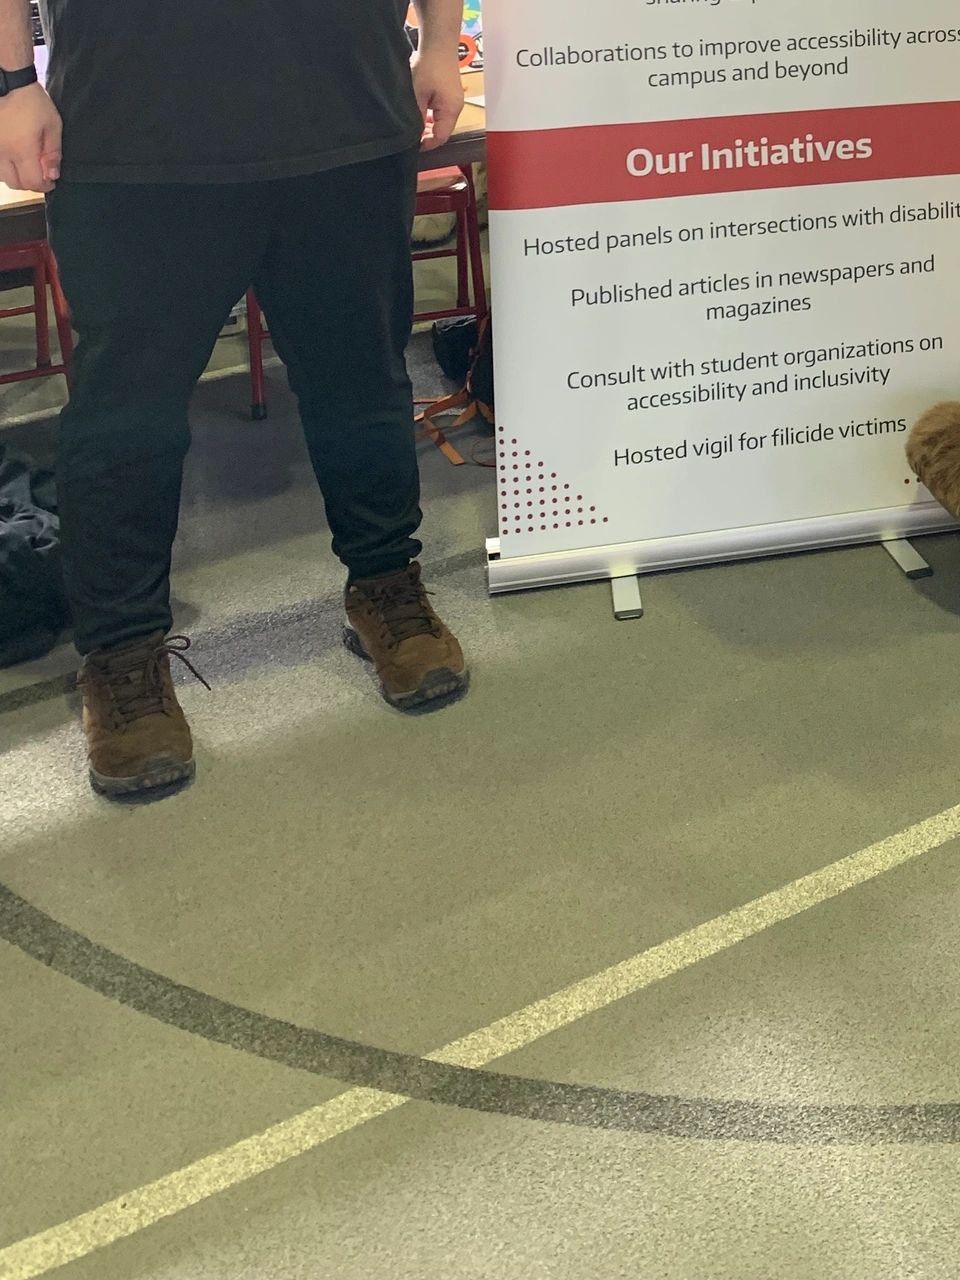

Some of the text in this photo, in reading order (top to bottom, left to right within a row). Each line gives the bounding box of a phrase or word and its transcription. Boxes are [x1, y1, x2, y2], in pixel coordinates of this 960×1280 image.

[516, 43, 667, 68] Collaborations
[671, 42, 694, 59] to
[699, 38, 781, 60] improve
[786, 27, 902, 51] accessibility
[647, 55, 849, 89] campus and beyond
[626, 133, 873, 177] Our Initiatives
[523, 230, 600, 257] Hosted
[606, 225, 673, 254] panels
[678, 227, 704, 242] on
[709, 213, 838, 239] intersections
[841, 206, 884, 227] with
[571, 253, 935, 307] Published articles in newspapers and
[706, 295, 811, 322] magazines
[567, 336, 943, 390] Consult with student organizations on
[627, 365, 891, 411] accessibility and inclusivity
[614, 417, 907, 467] Hosted vigil for filicide victims
